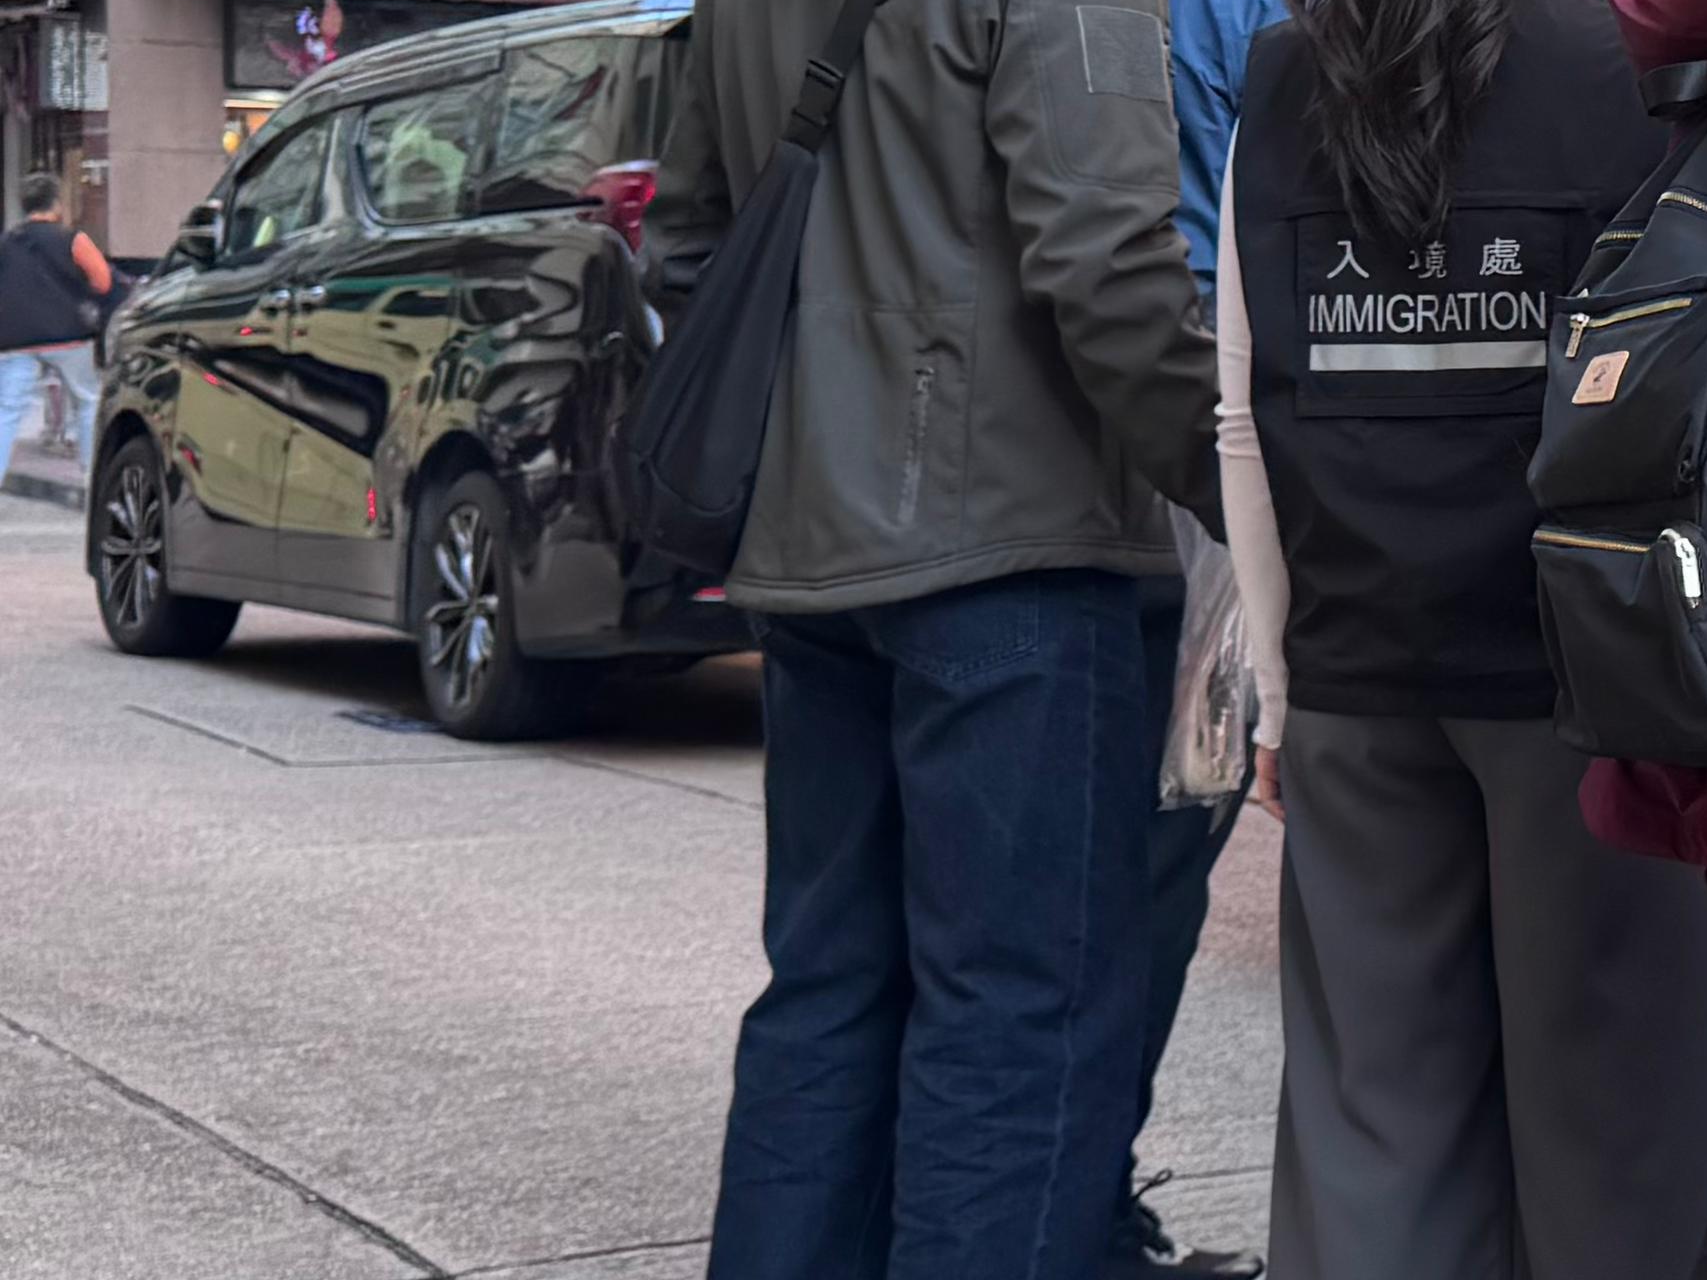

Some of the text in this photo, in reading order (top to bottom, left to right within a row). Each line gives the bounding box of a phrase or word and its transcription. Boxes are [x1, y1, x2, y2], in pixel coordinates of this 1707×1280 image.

[1326, 237, 1523, 279] 入境處
[1309, 290, 1547, 333] IMMIGRATION
